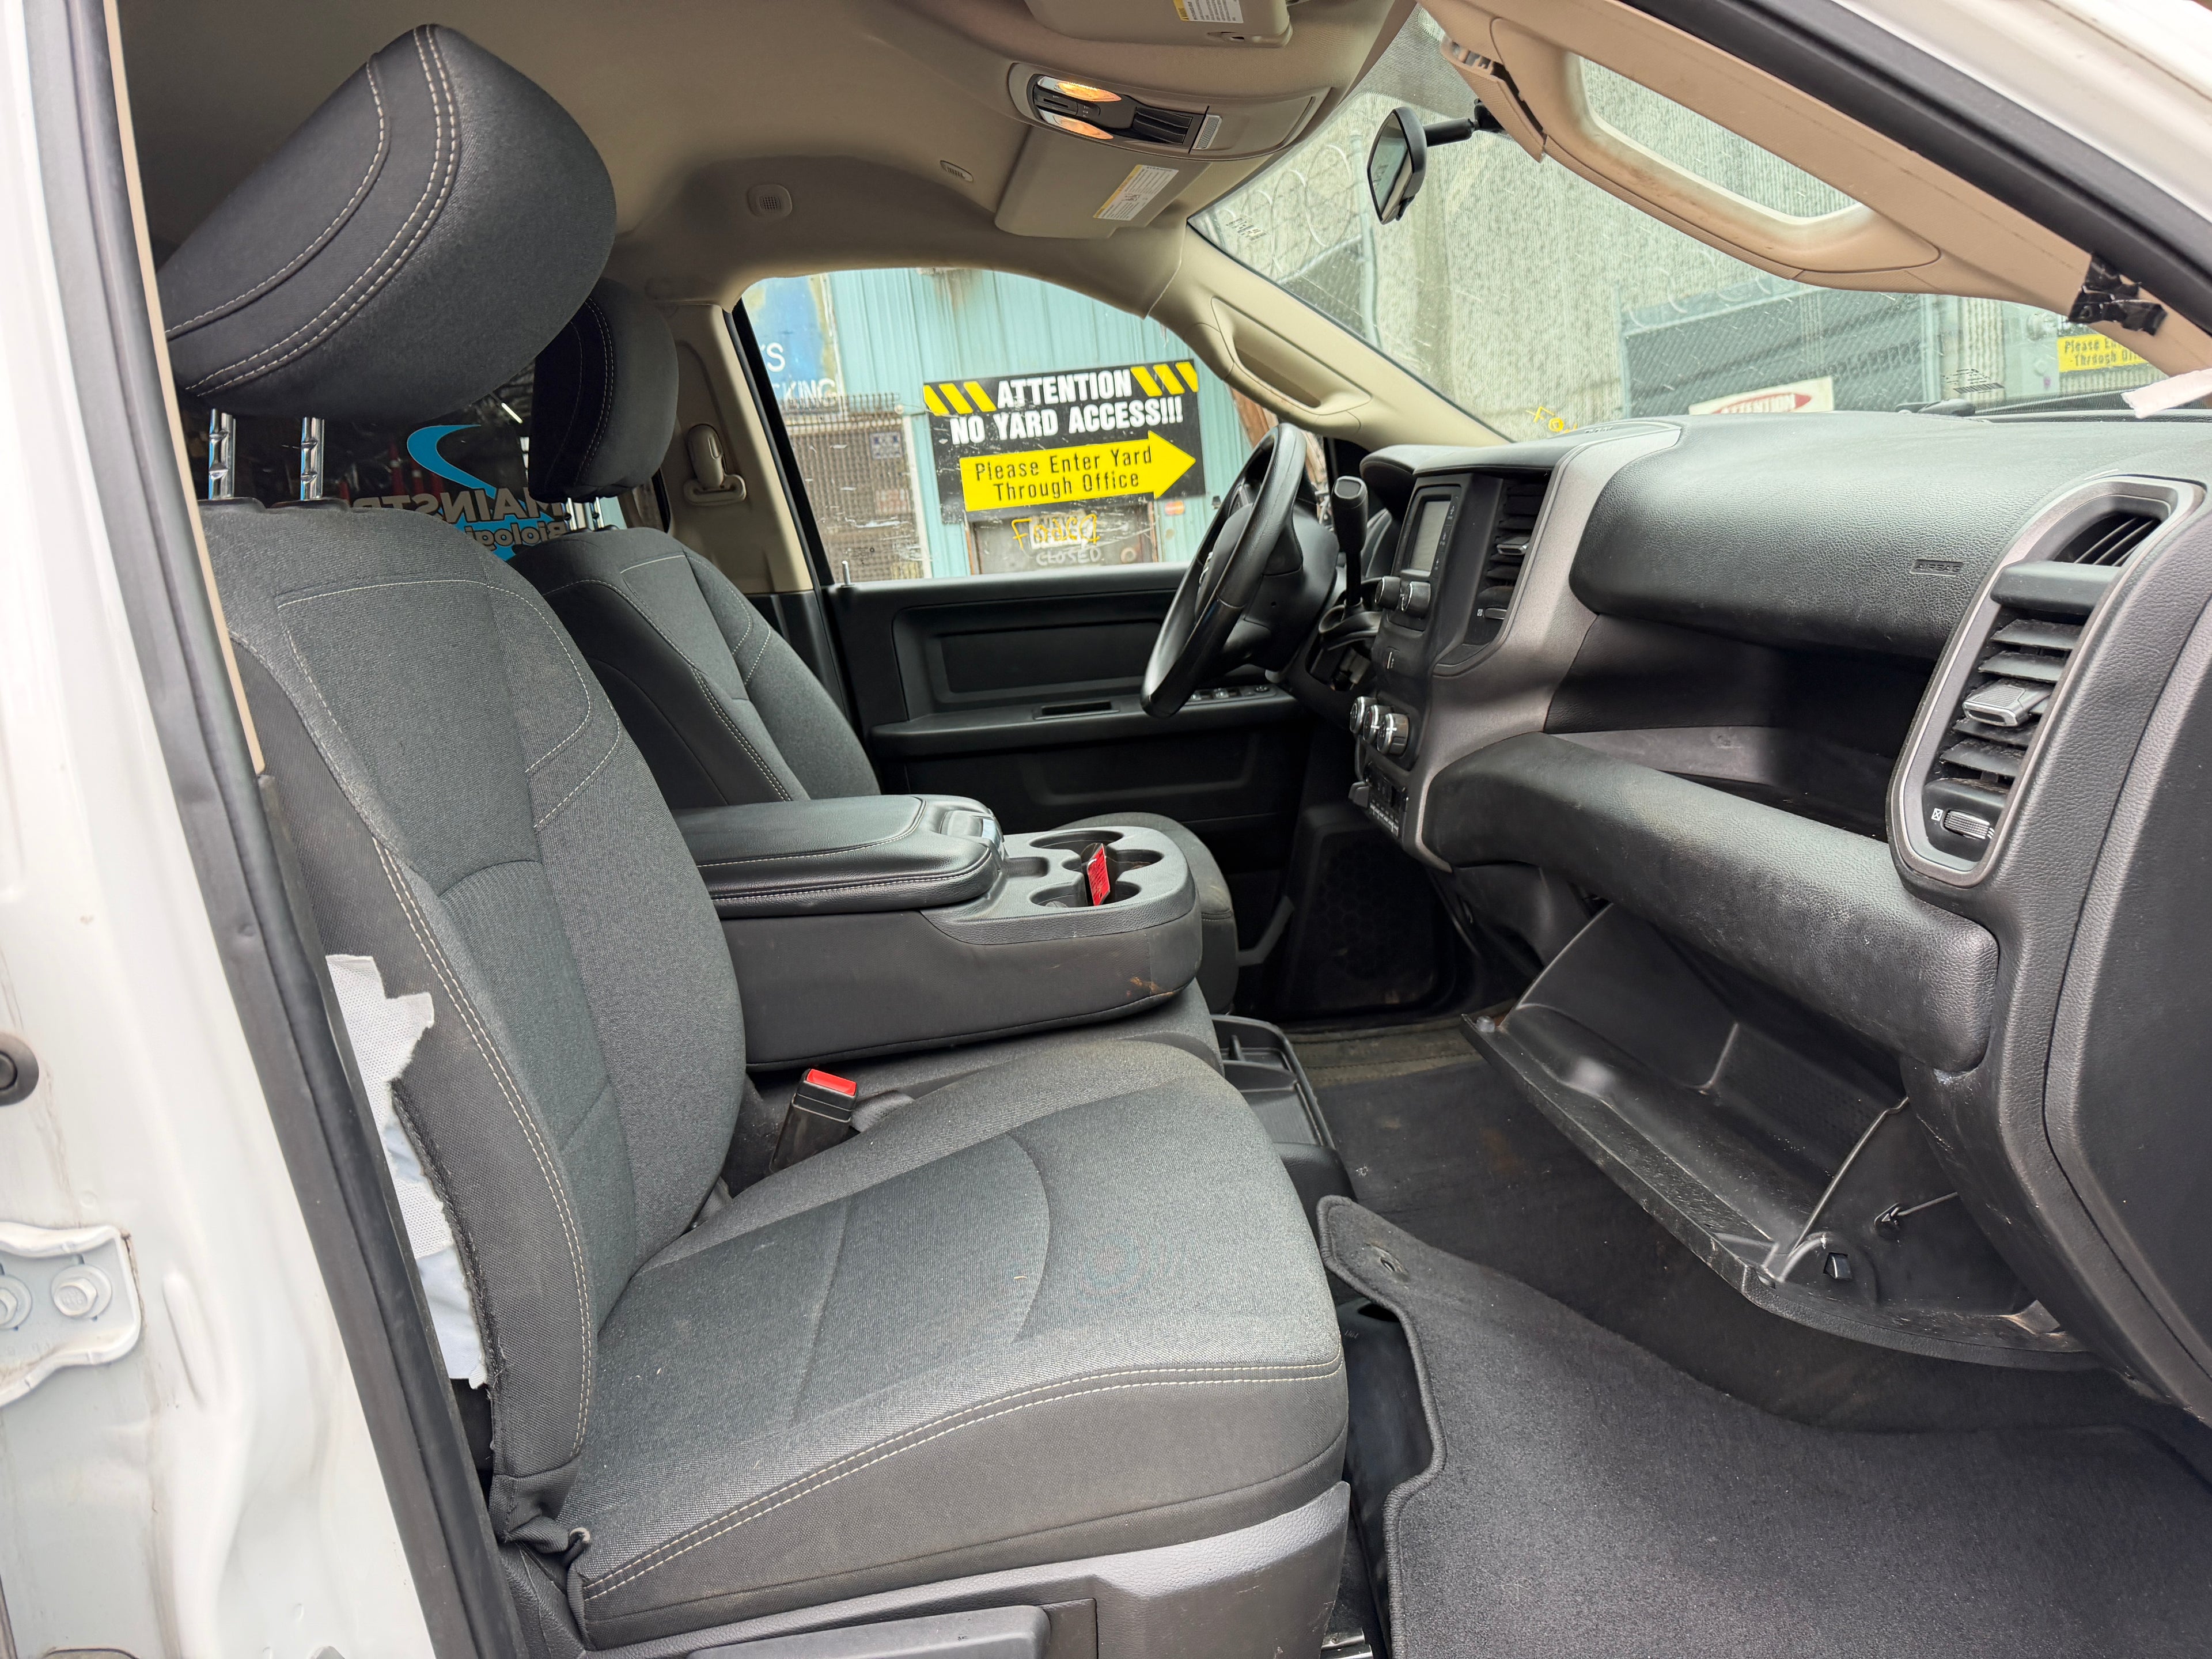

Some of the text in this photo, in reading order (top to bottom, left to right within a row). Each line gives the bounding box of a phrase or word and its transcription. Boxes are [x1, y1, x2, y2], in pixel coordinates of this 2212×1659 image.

[2065, 339, 2100, 354] Please
[997, 369, 1132, 409] ATTENTION
[949, 396, 1183, 445] NO YARD ACCESS!!!
[975, 445, 1152, 481] Please Enter Yard
[993, 471, 1139, 502] Through Office
